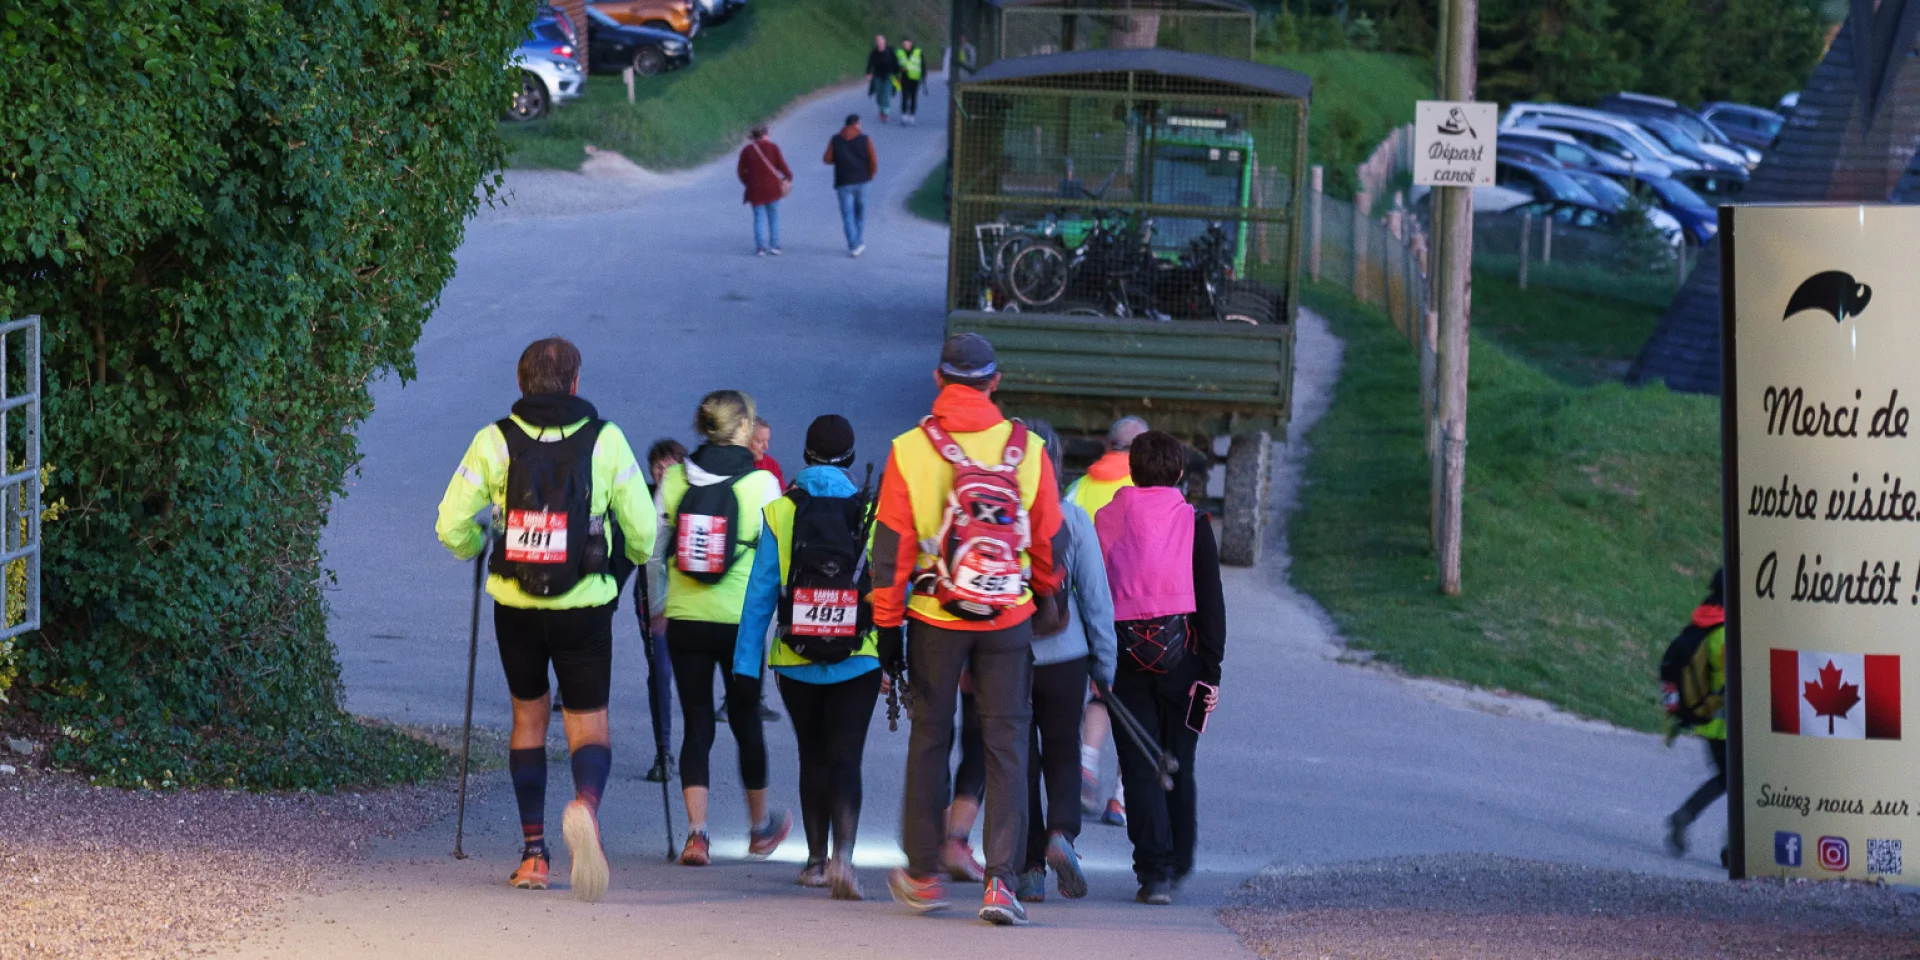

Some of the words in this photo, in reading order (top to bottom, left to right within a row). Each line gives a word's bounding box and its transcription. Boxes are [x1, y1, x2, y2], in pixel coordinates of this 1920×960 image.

[1428, 141, 1484, 165] Départ
[1433, 166, 1477, 183] canoë
[1764, 385, 1861, 438] Merci
[1867, 388, 1909, 438] de
[1748, 474, 1817, 520] votre
[518, 530, 553, 549] 491
[1755, 550, 1778, 600] A
[1791, 553, 1901, 605] bientôt
[805, 605, 846, 623] 493
[1756, 783, 1811, 817] Suivez
[1816, 797, 1864, 815] nous
[1870, 799, 1909, 816] sur
